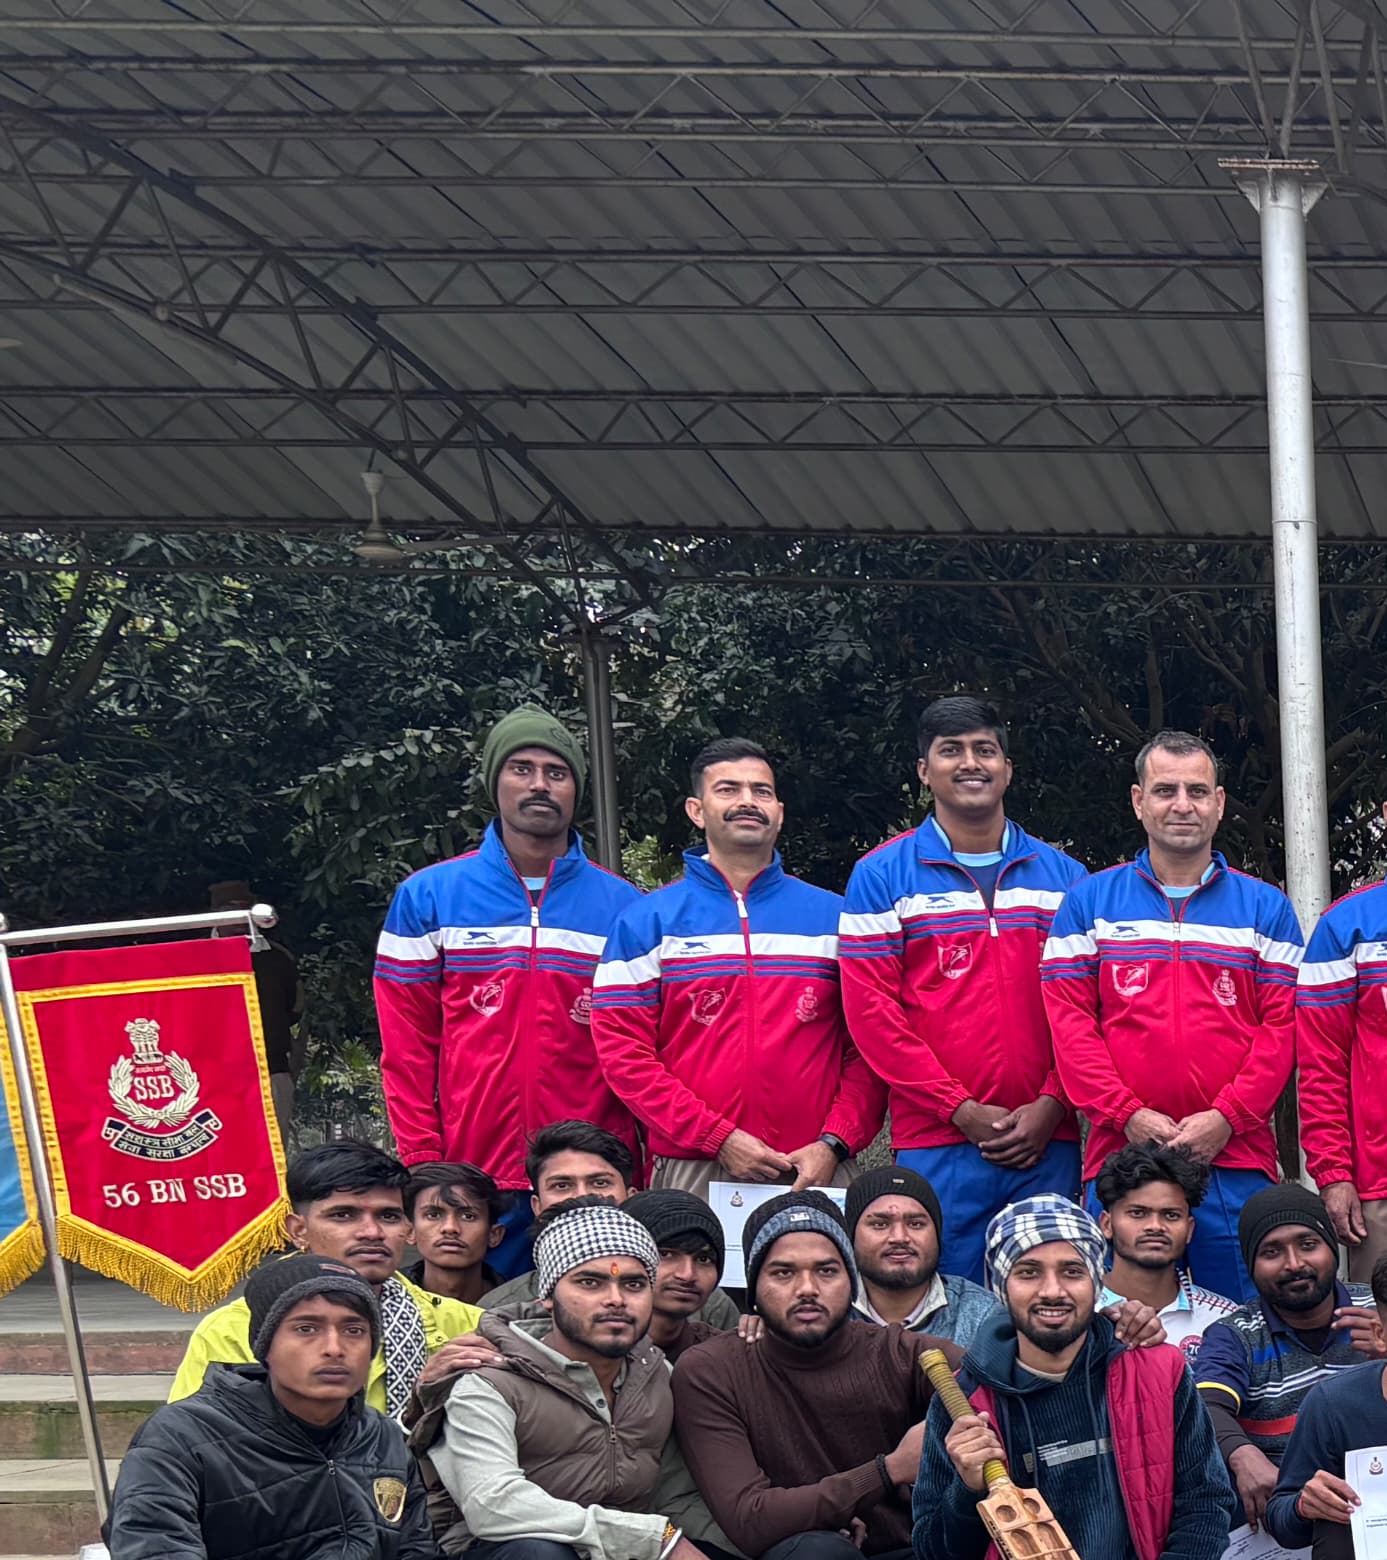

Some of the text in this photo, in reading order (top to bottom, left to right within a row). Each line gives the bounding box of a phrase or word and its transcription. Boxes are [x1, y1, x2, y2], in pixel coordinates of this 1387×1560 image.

[134, 1075, 175, 1101] SSB
[102, 1173, 247, 1208] 56 BN SSB
